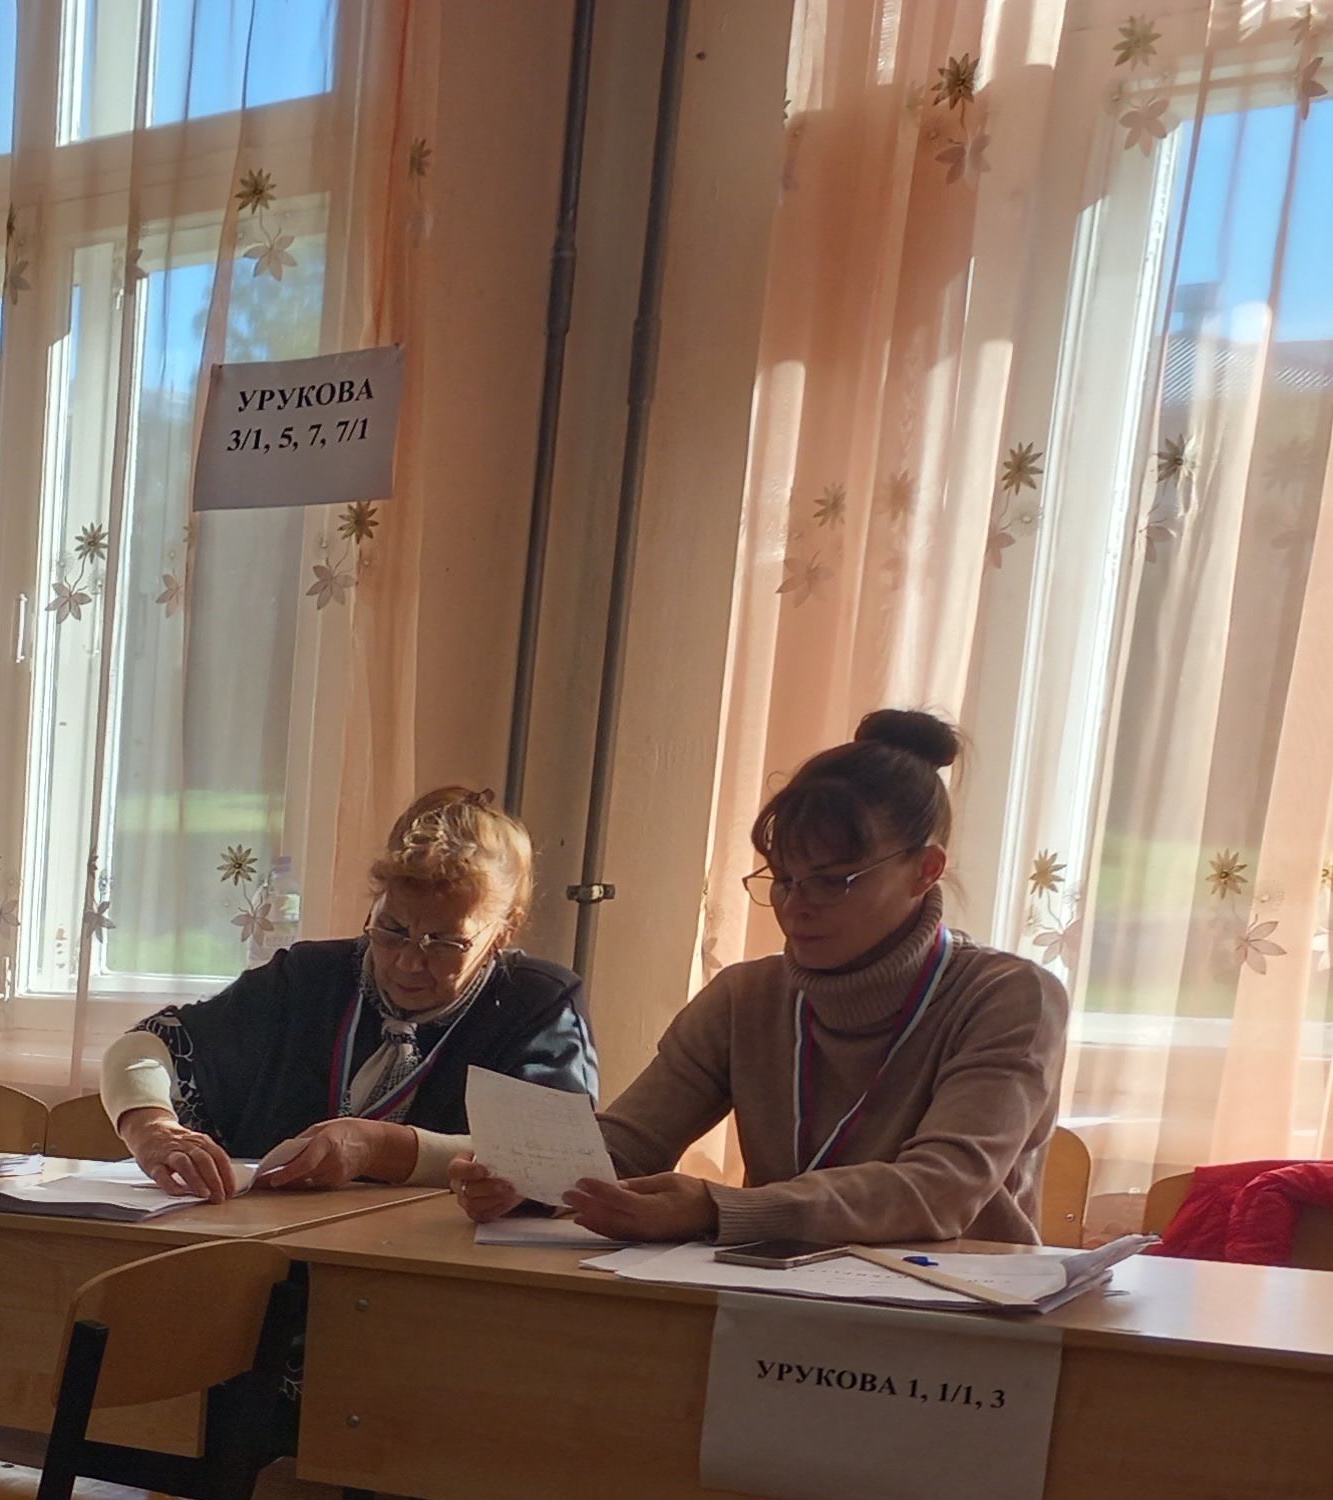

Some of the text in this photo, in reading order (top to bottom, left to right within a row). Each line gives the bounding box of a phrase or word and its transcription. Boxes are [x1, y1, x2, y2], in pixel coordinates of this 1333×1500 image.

[238, 378, 374, 412] УРУКОВА
[227, 417, 369, 454] 3/1, 5, 7, 7/1
[756, 1360, 1006, 1411] УРУКОВА 1, 1/1, 3
